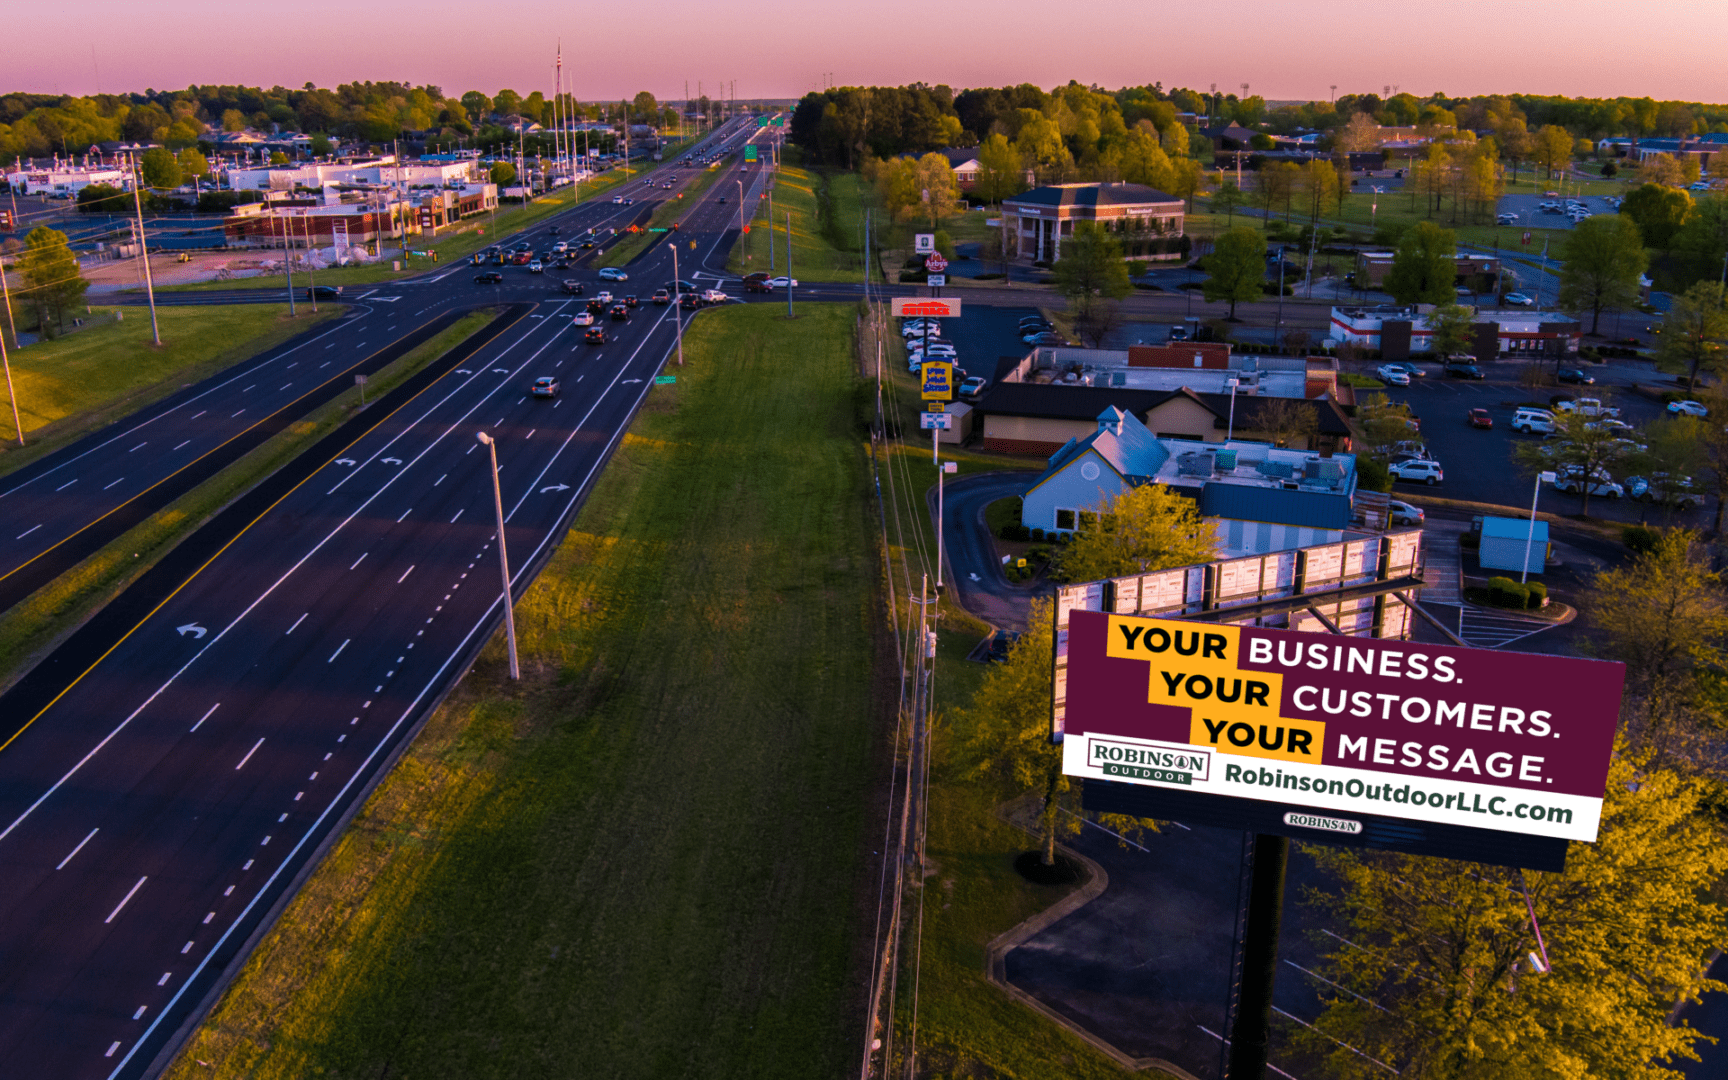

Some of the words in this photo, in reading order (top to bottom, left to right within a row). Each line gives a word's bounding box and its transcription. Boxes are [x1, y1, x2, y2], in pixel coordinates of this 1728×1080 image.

[1118, 624, 1228, 660] YOUR
[1249, 637, 1463, 684] BUSINESS.
[1160, 670, 1271, 707] YOUR
[1292, 685, 1561, 740] CUSTOMERS.
[1094, 744, 1204, 771] ROBINSON
[1110, 765, 1185, 782] OUTDOOR
[1202, 718, 1313, 755] YOUR
[1337, 734, 1555, 784] MESSAGE.
[1225, 763, 1573, 824] RobinsonOutdoorLLC.com
[1288, 813, 1358, 833] ROBINSON
